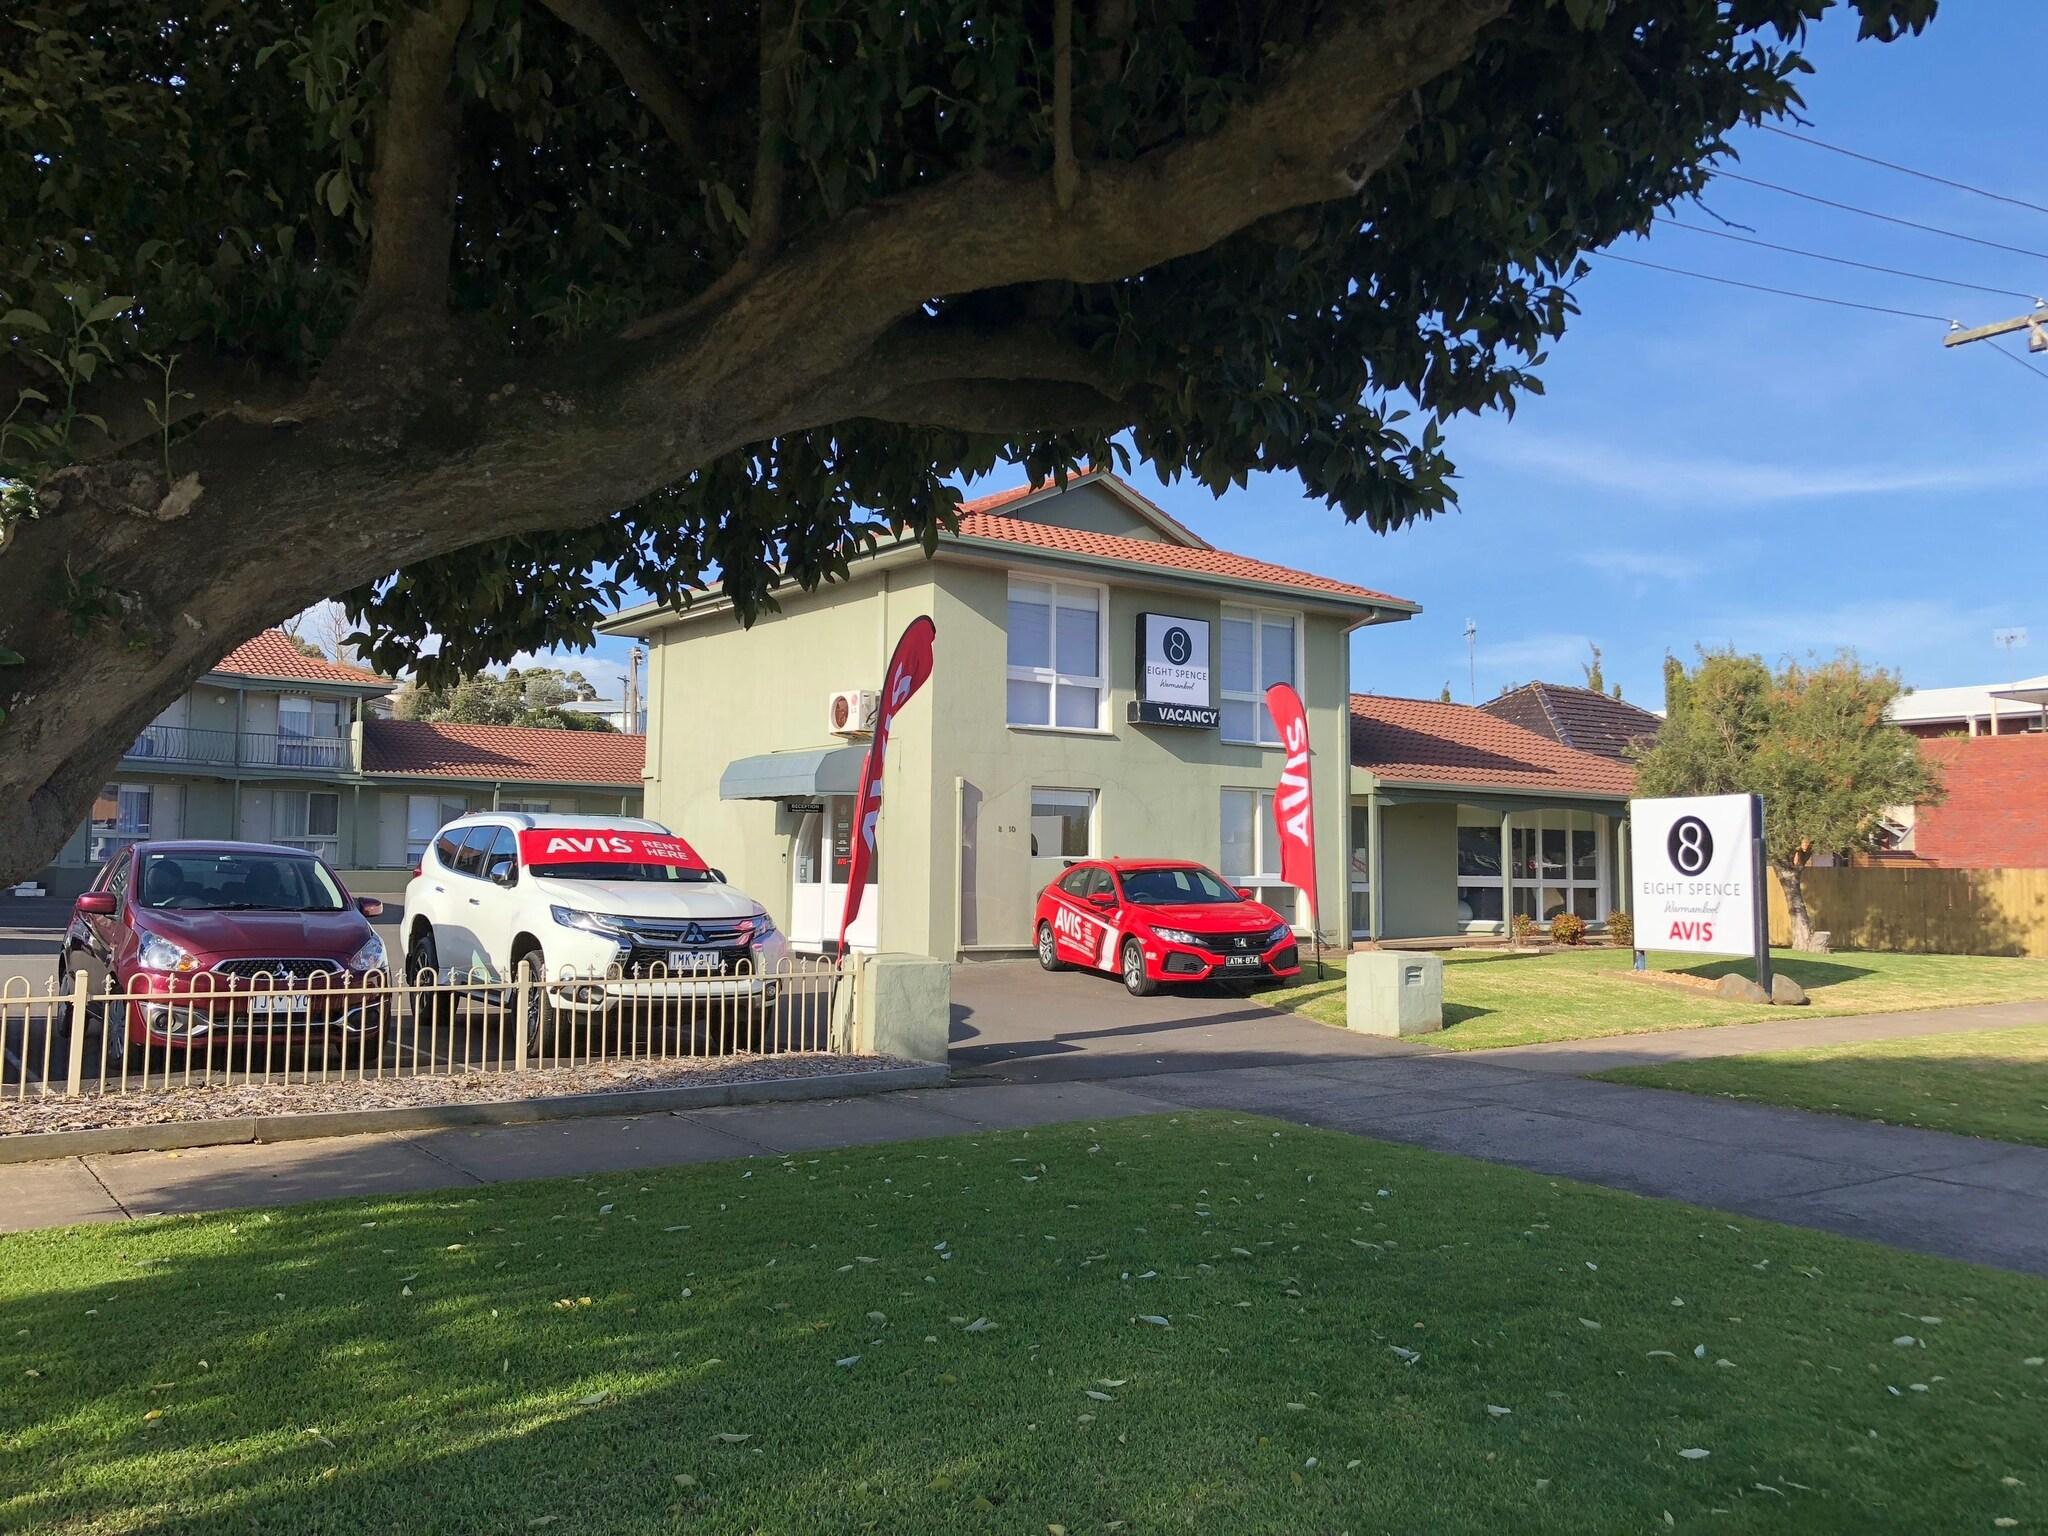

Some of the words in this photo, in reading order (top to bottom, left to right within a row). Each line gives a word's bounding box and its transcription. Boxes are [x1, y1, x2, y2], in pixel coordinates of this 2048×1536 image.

[1169, 631, 1185, 662] 8
[1147, 666, 1173, 677] EIGHT
[1175, 669, 1207, 681] SPENCE
[1158, 707, 1217, 725] VACANCY
[1280, 716, 1311, 847] AVIS
[546, 837, 633, 854] AVIS
[640, 840, 682, 852] RENT
[647, 848, 689, 861] HERE
[1677, 822, 1704, 872] 8
[1643, 882, 1683, 895] EIGHT
[1688, 882, 1741, 896] SPENCE
[1054, 907, 1082, 941] AVIS
[1668, 920, 1713, 942] AVIS
